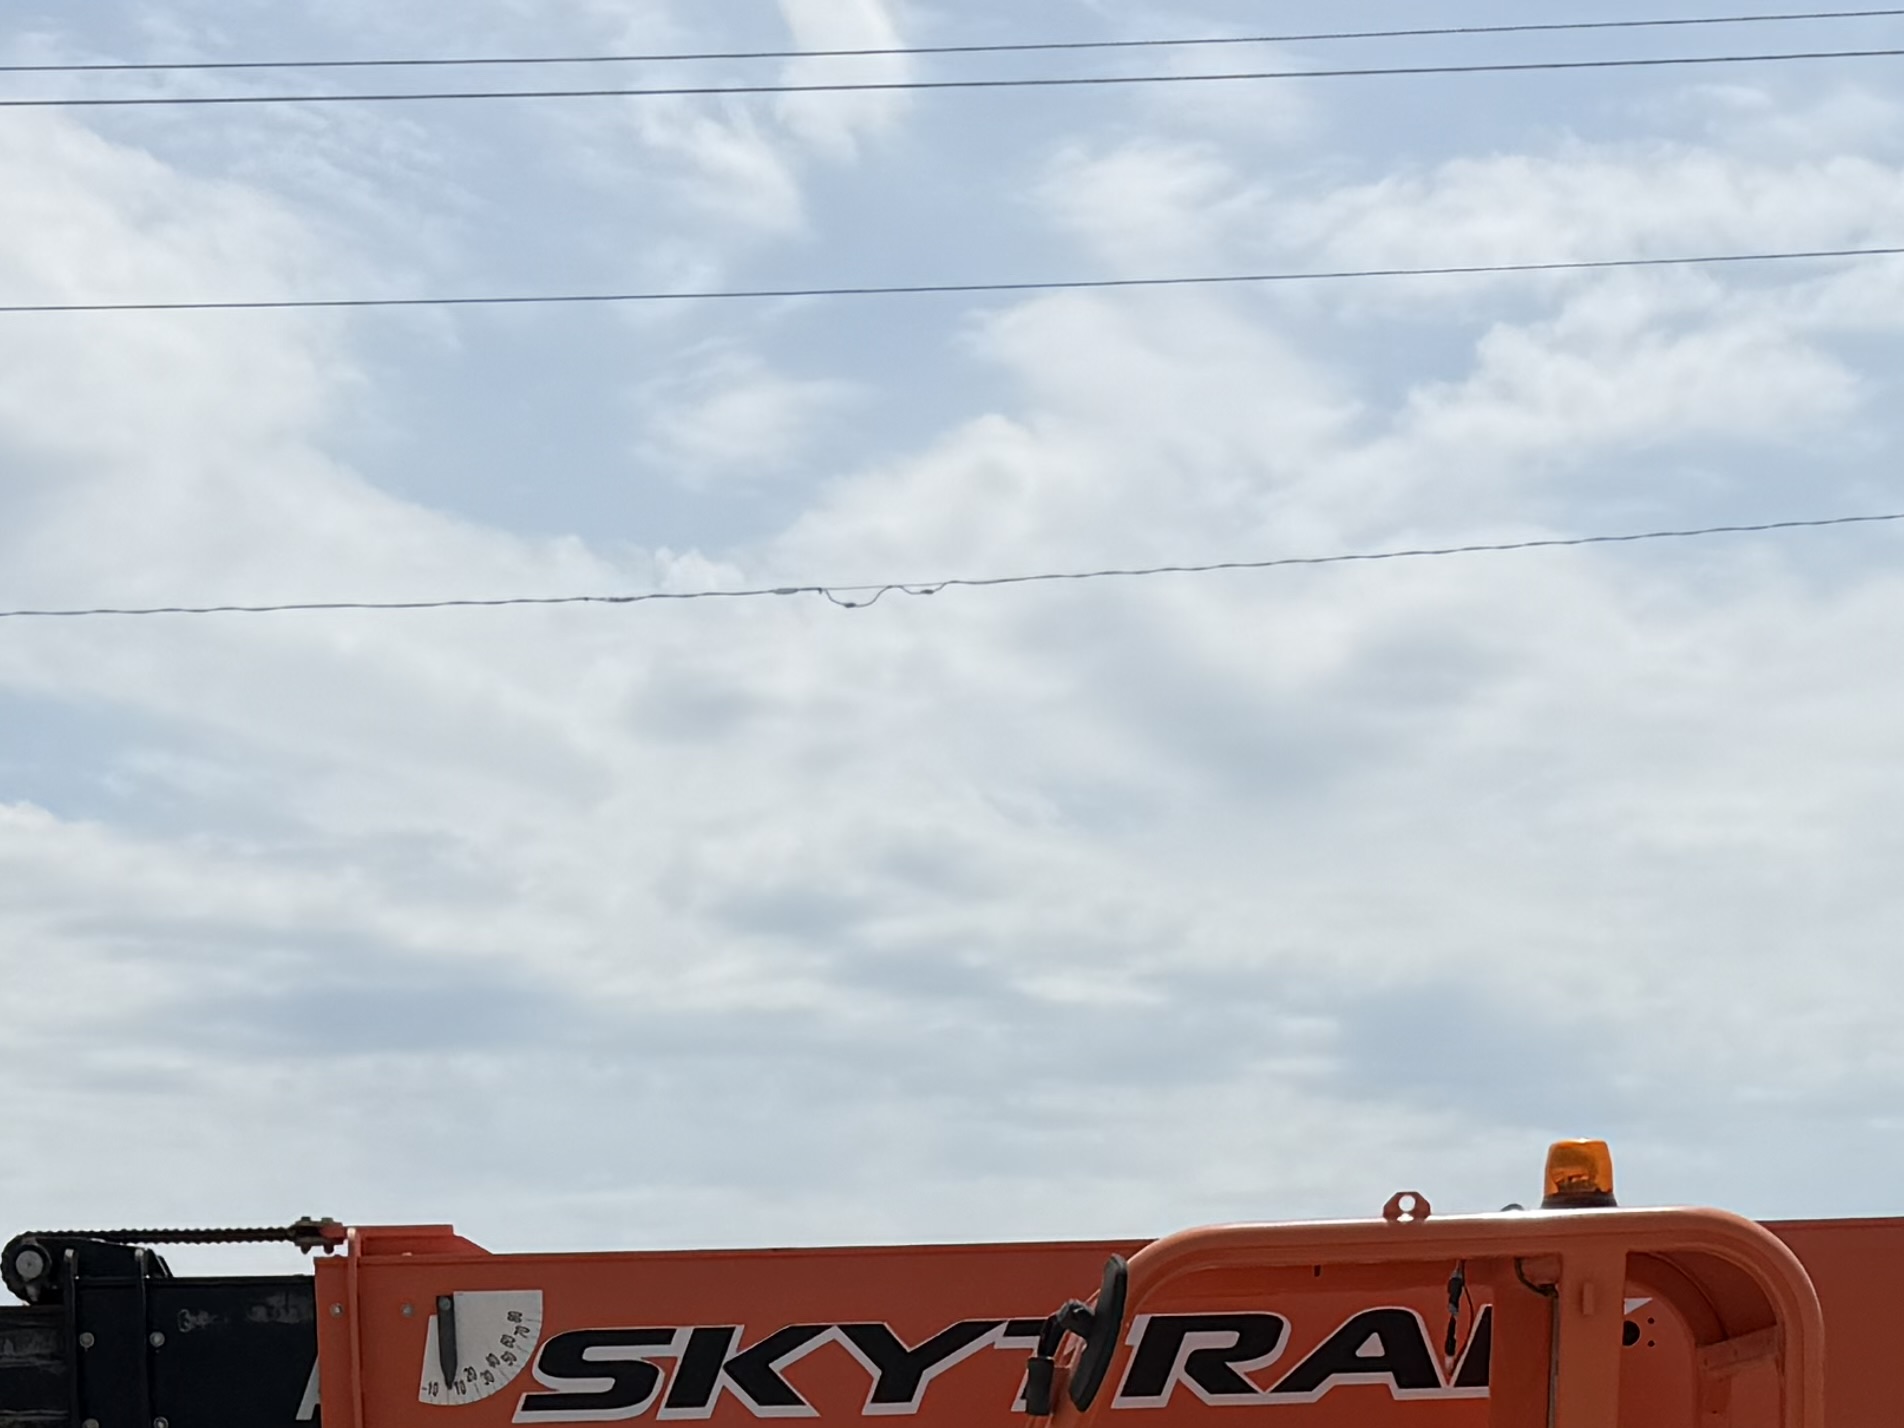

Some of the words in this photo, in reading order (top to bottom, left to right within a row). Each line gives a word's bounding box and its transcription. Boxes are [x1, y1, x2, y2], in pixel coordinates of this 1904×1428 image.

[454, 1380, 467, 1395] 10
[463, 1366, 478, 1383] 20
[513, 1325, 530, 1339] 70
[513, 1305, 1491, 1424] SKYRA
